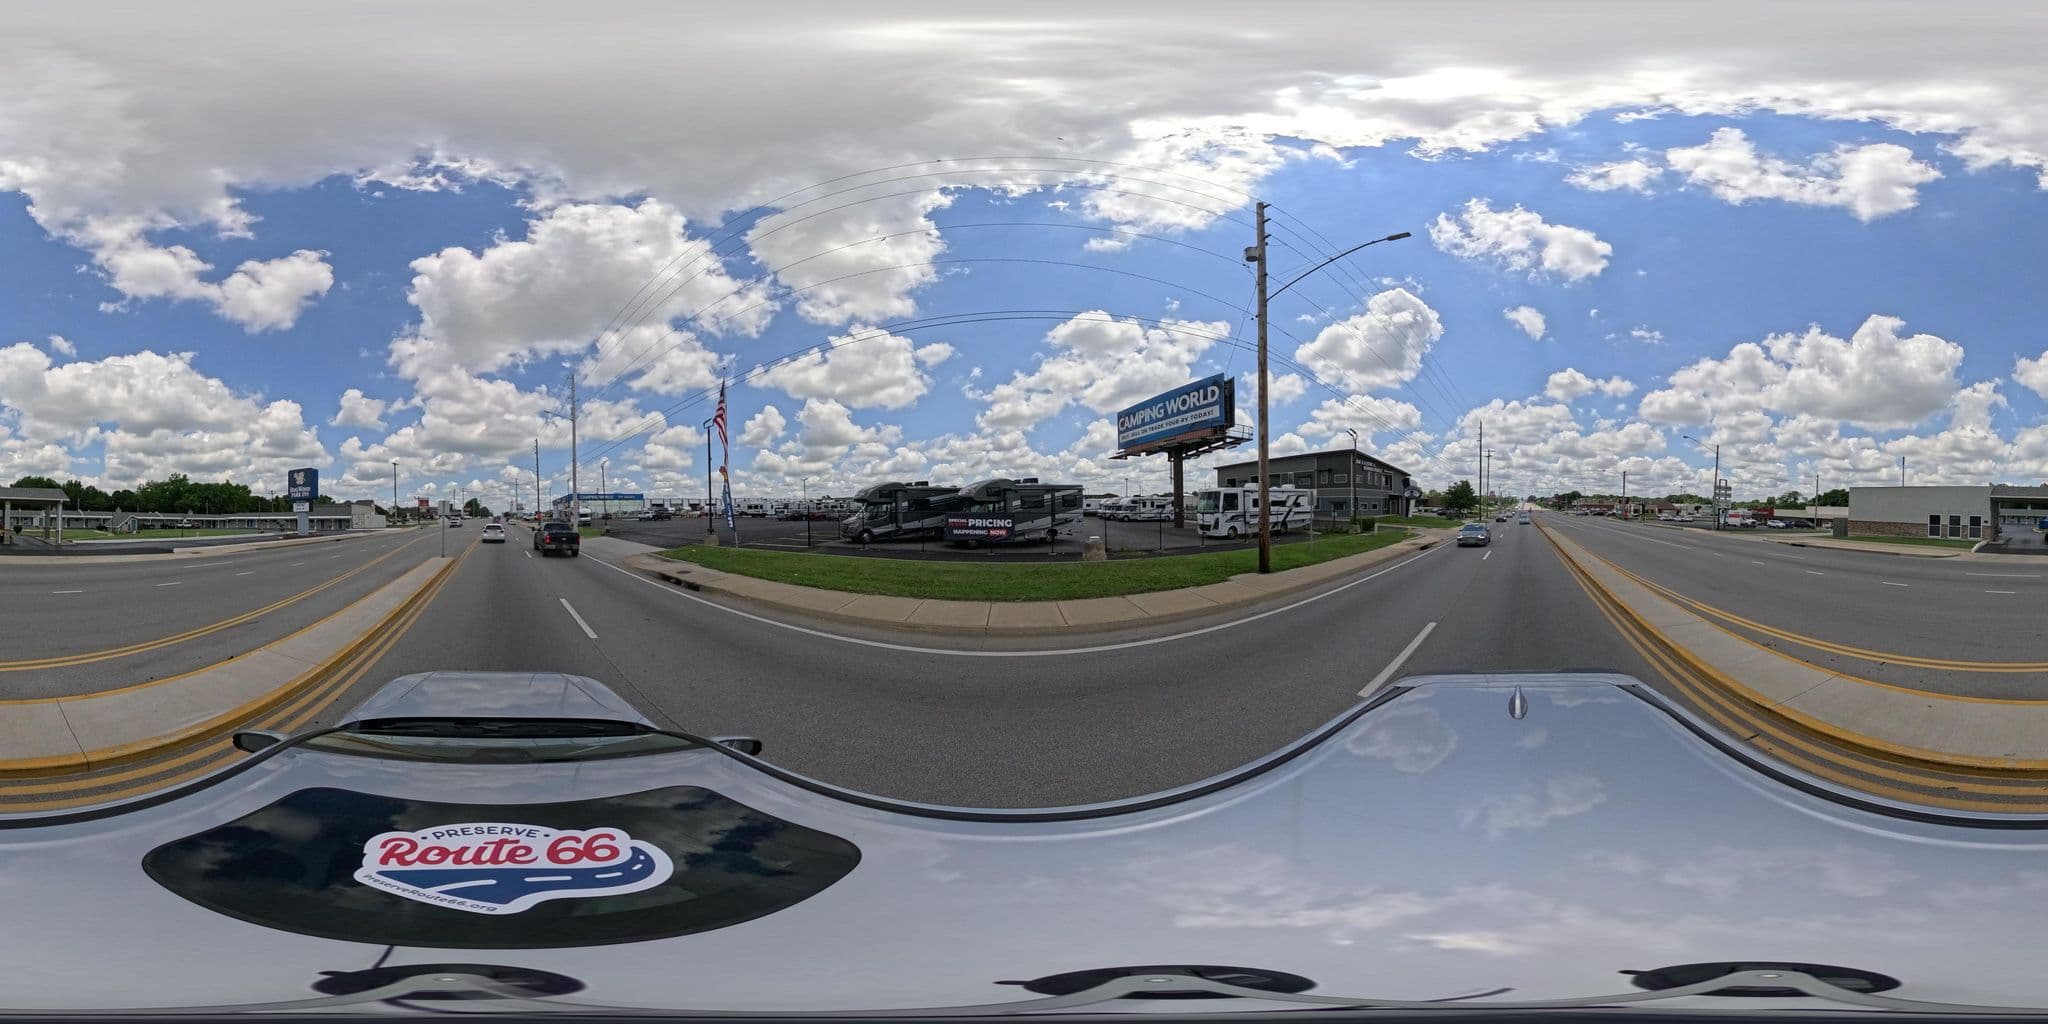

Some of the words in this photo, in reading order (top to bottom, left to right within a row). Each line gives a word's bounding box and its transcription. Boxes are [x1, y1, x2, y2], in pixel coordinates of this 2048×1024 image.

[1118, 403, 1164, 431] CAMPING
[1166, 386, 1219, 414] WORLD
[1148, 423, 1164, 433] TRADE
[1164, 418, 1180, 428] YOUR
[1180, 416, 1190, 425] RV
[1190, 409, 1214, 422] TODAY!
[968, 518, 1012, 527] PRICING
[432, 825, 541, 841] PRESERVE
[378, 837, 538, 867] Route
[546, 833, 620, 864] 66
[362, 872, 498, 913] PreserveRoute66.org
